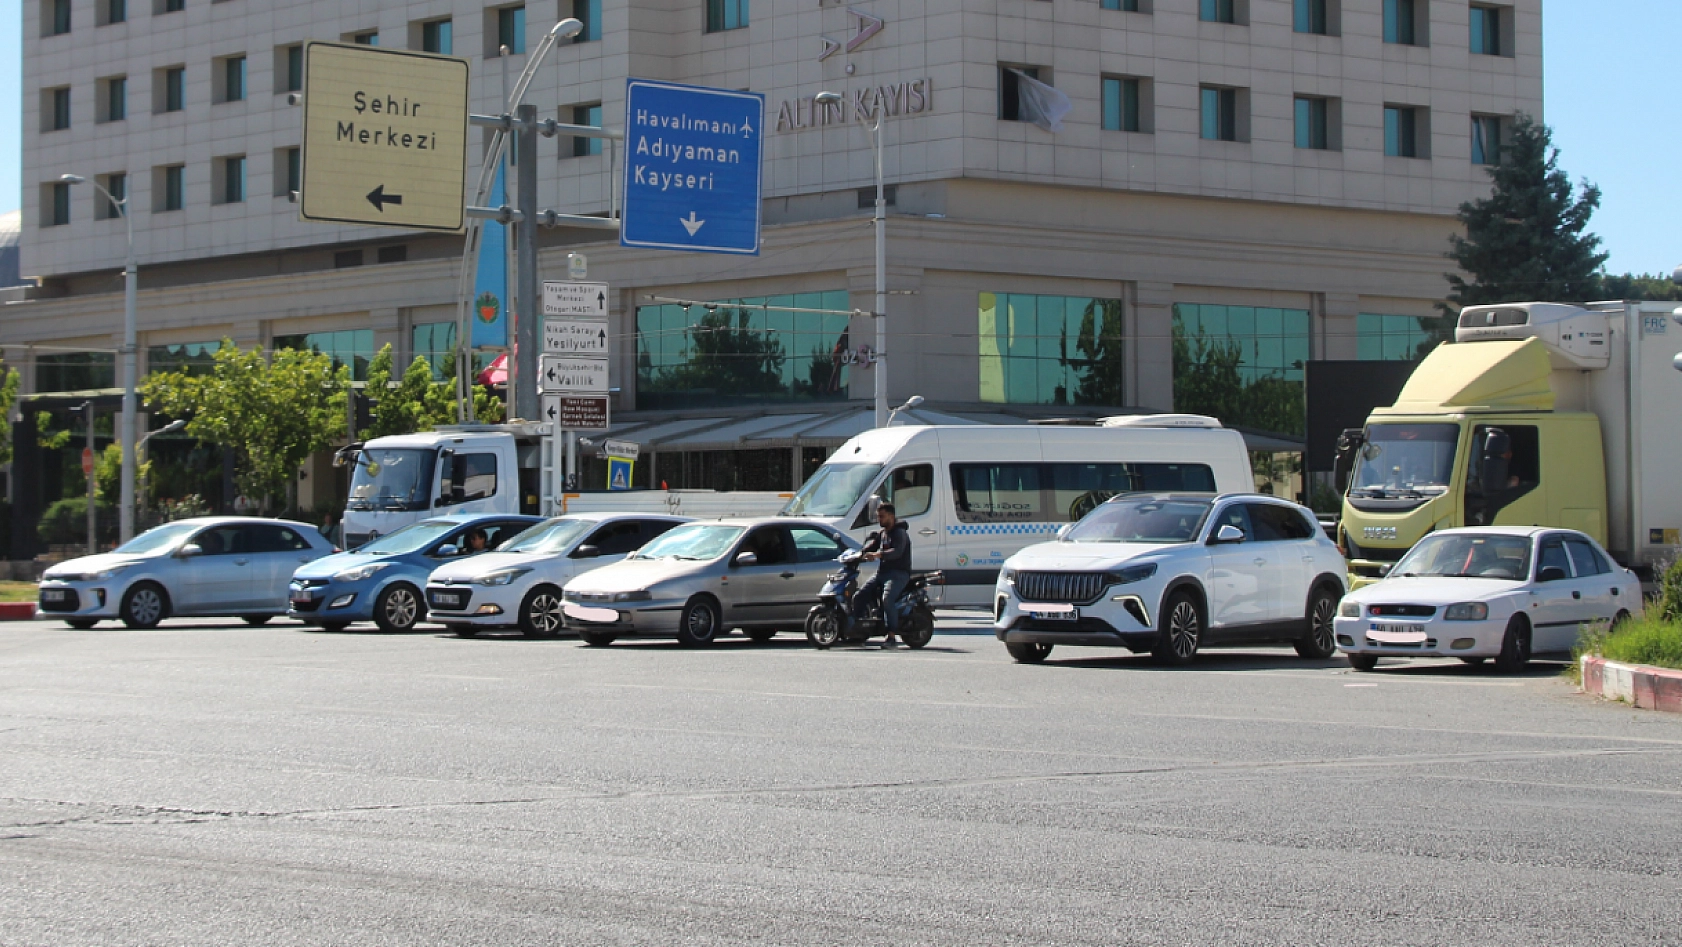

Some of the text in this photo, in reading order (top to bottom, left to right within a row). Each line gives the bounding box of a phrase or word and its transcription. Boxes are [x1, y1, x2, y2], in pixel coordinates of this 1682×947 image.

[354, 90, 421, 117] Şehir
[776, 77, 933, 131] ALTIN KAYISI
[337, 120, 436, 150] Merkezi
[636, 135, 739, 164] Adıyaman
[634, 164, 714, 192] Kayseri
[1644, 317, 1667, 328] FRC
[557, 374, 595, 386] Valilik
[1363, 526, 1397, 539] IVECO
